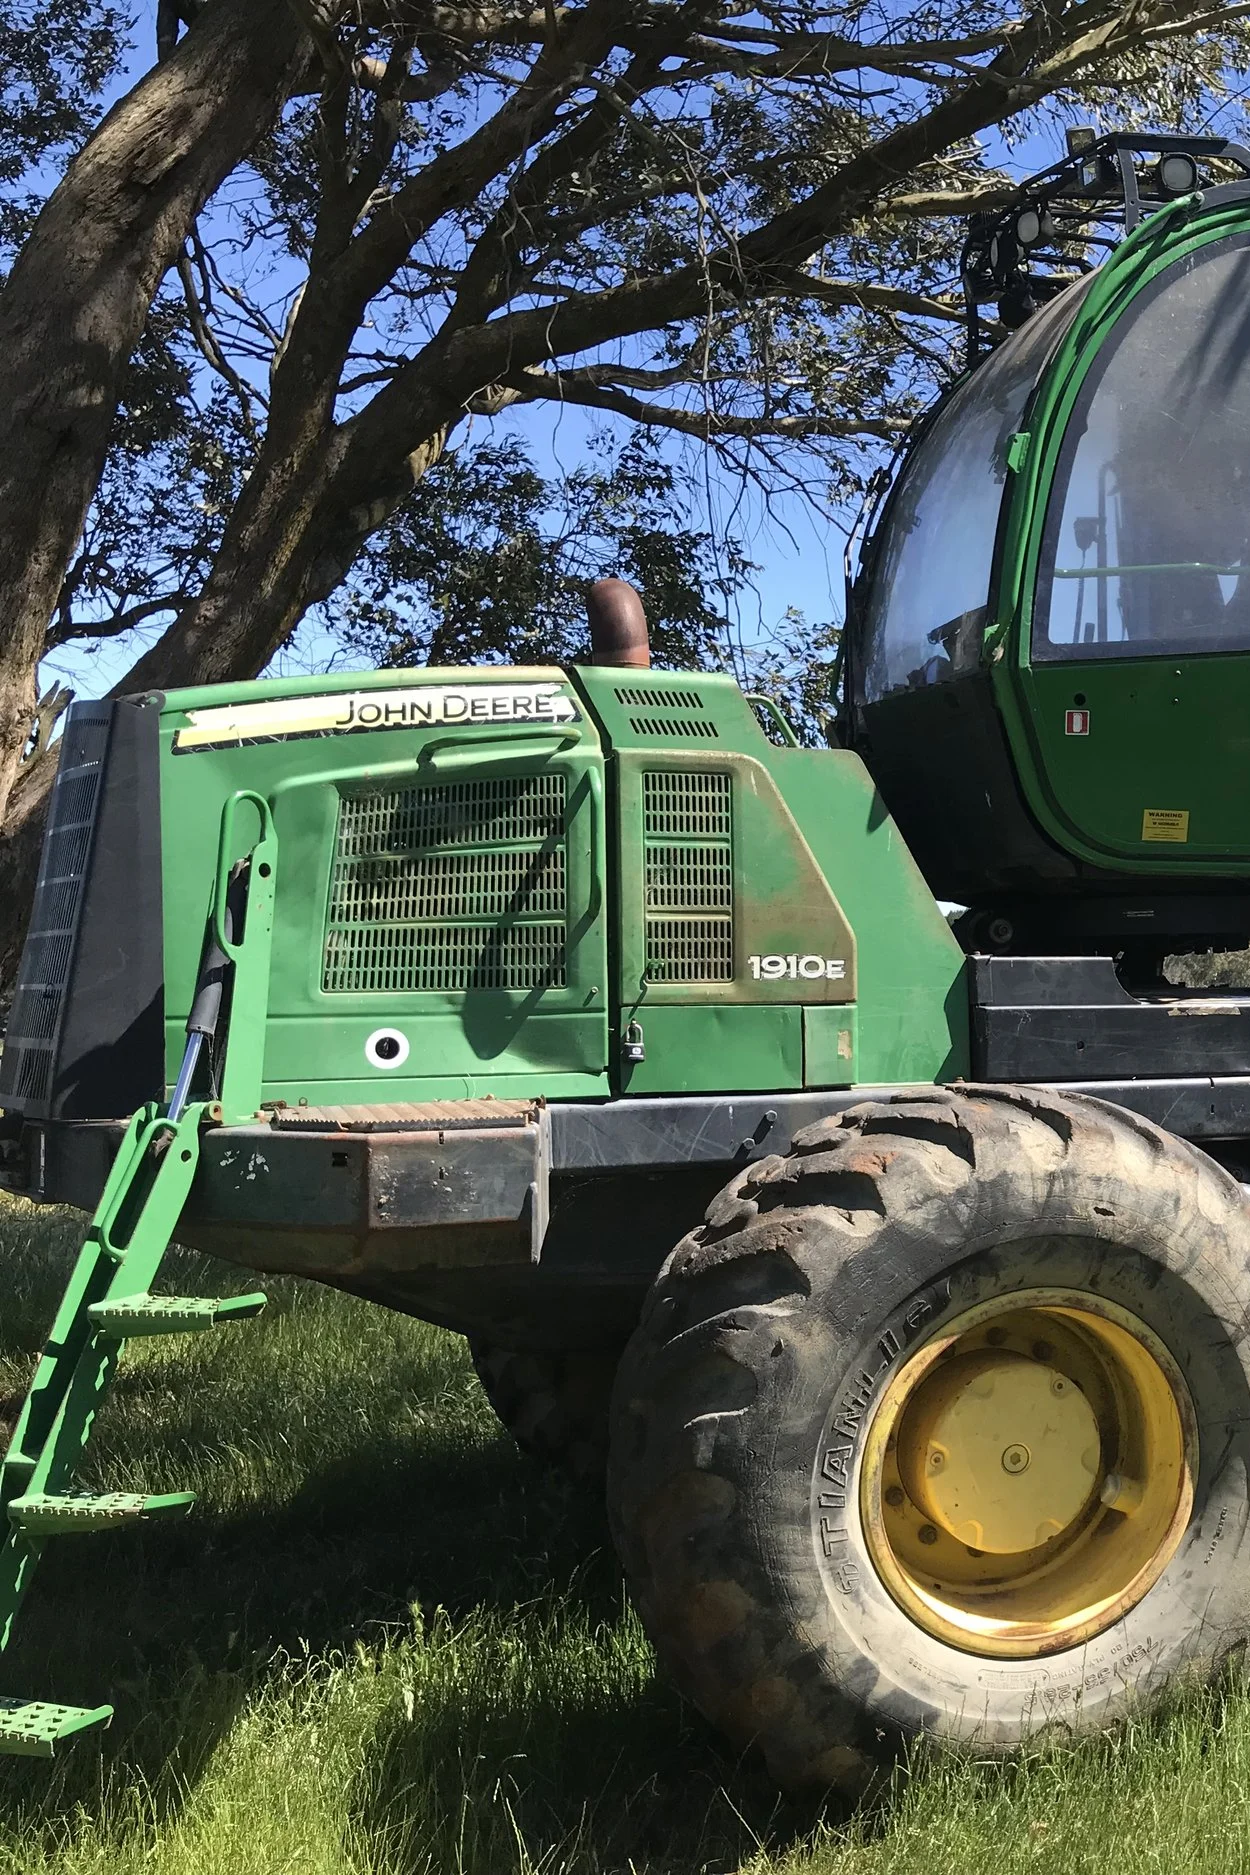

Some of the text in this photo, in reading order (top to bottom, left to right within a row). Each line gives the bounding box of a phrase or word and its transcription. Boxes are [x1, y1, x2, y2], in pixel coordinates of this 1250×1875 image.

[336, 695, 553, 726] JOHN DEERE
[747, 954, 847, 980] 1910E
